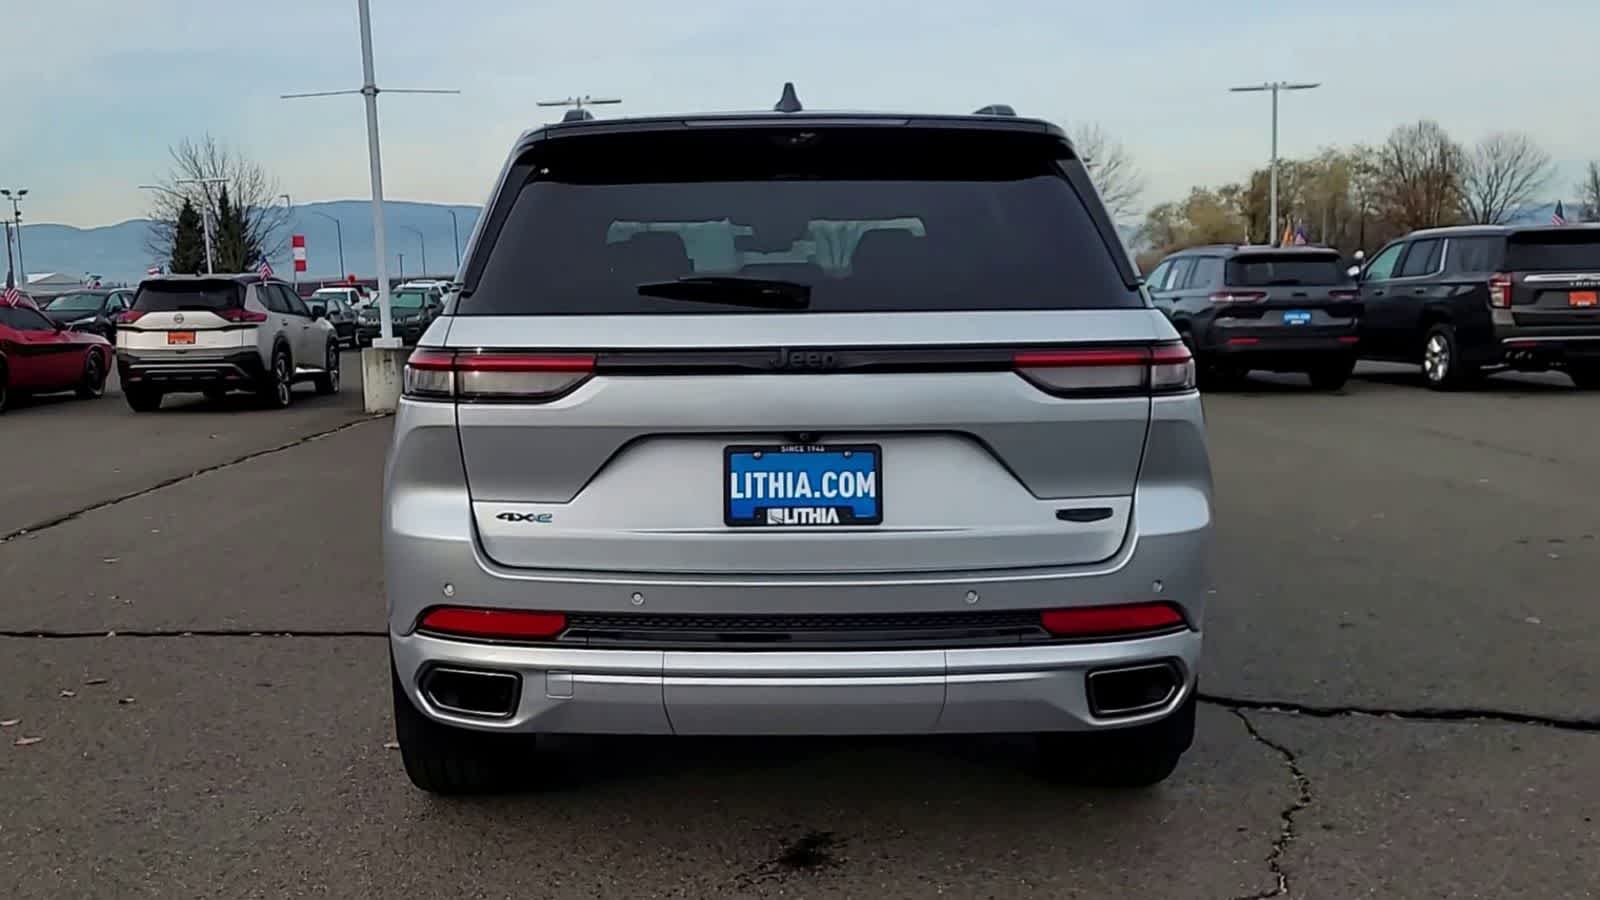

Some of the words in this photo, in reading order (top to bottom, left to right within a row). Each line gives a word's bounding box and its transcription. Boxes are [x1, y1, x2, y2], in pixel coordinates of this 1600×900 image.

[769, 347, 838, 370] Jeep
[781, 445, 804, 453] SINCE
[730, 471, 876, 499] LITHIA.COM
[783, 507, 840, 524] LITHIA
